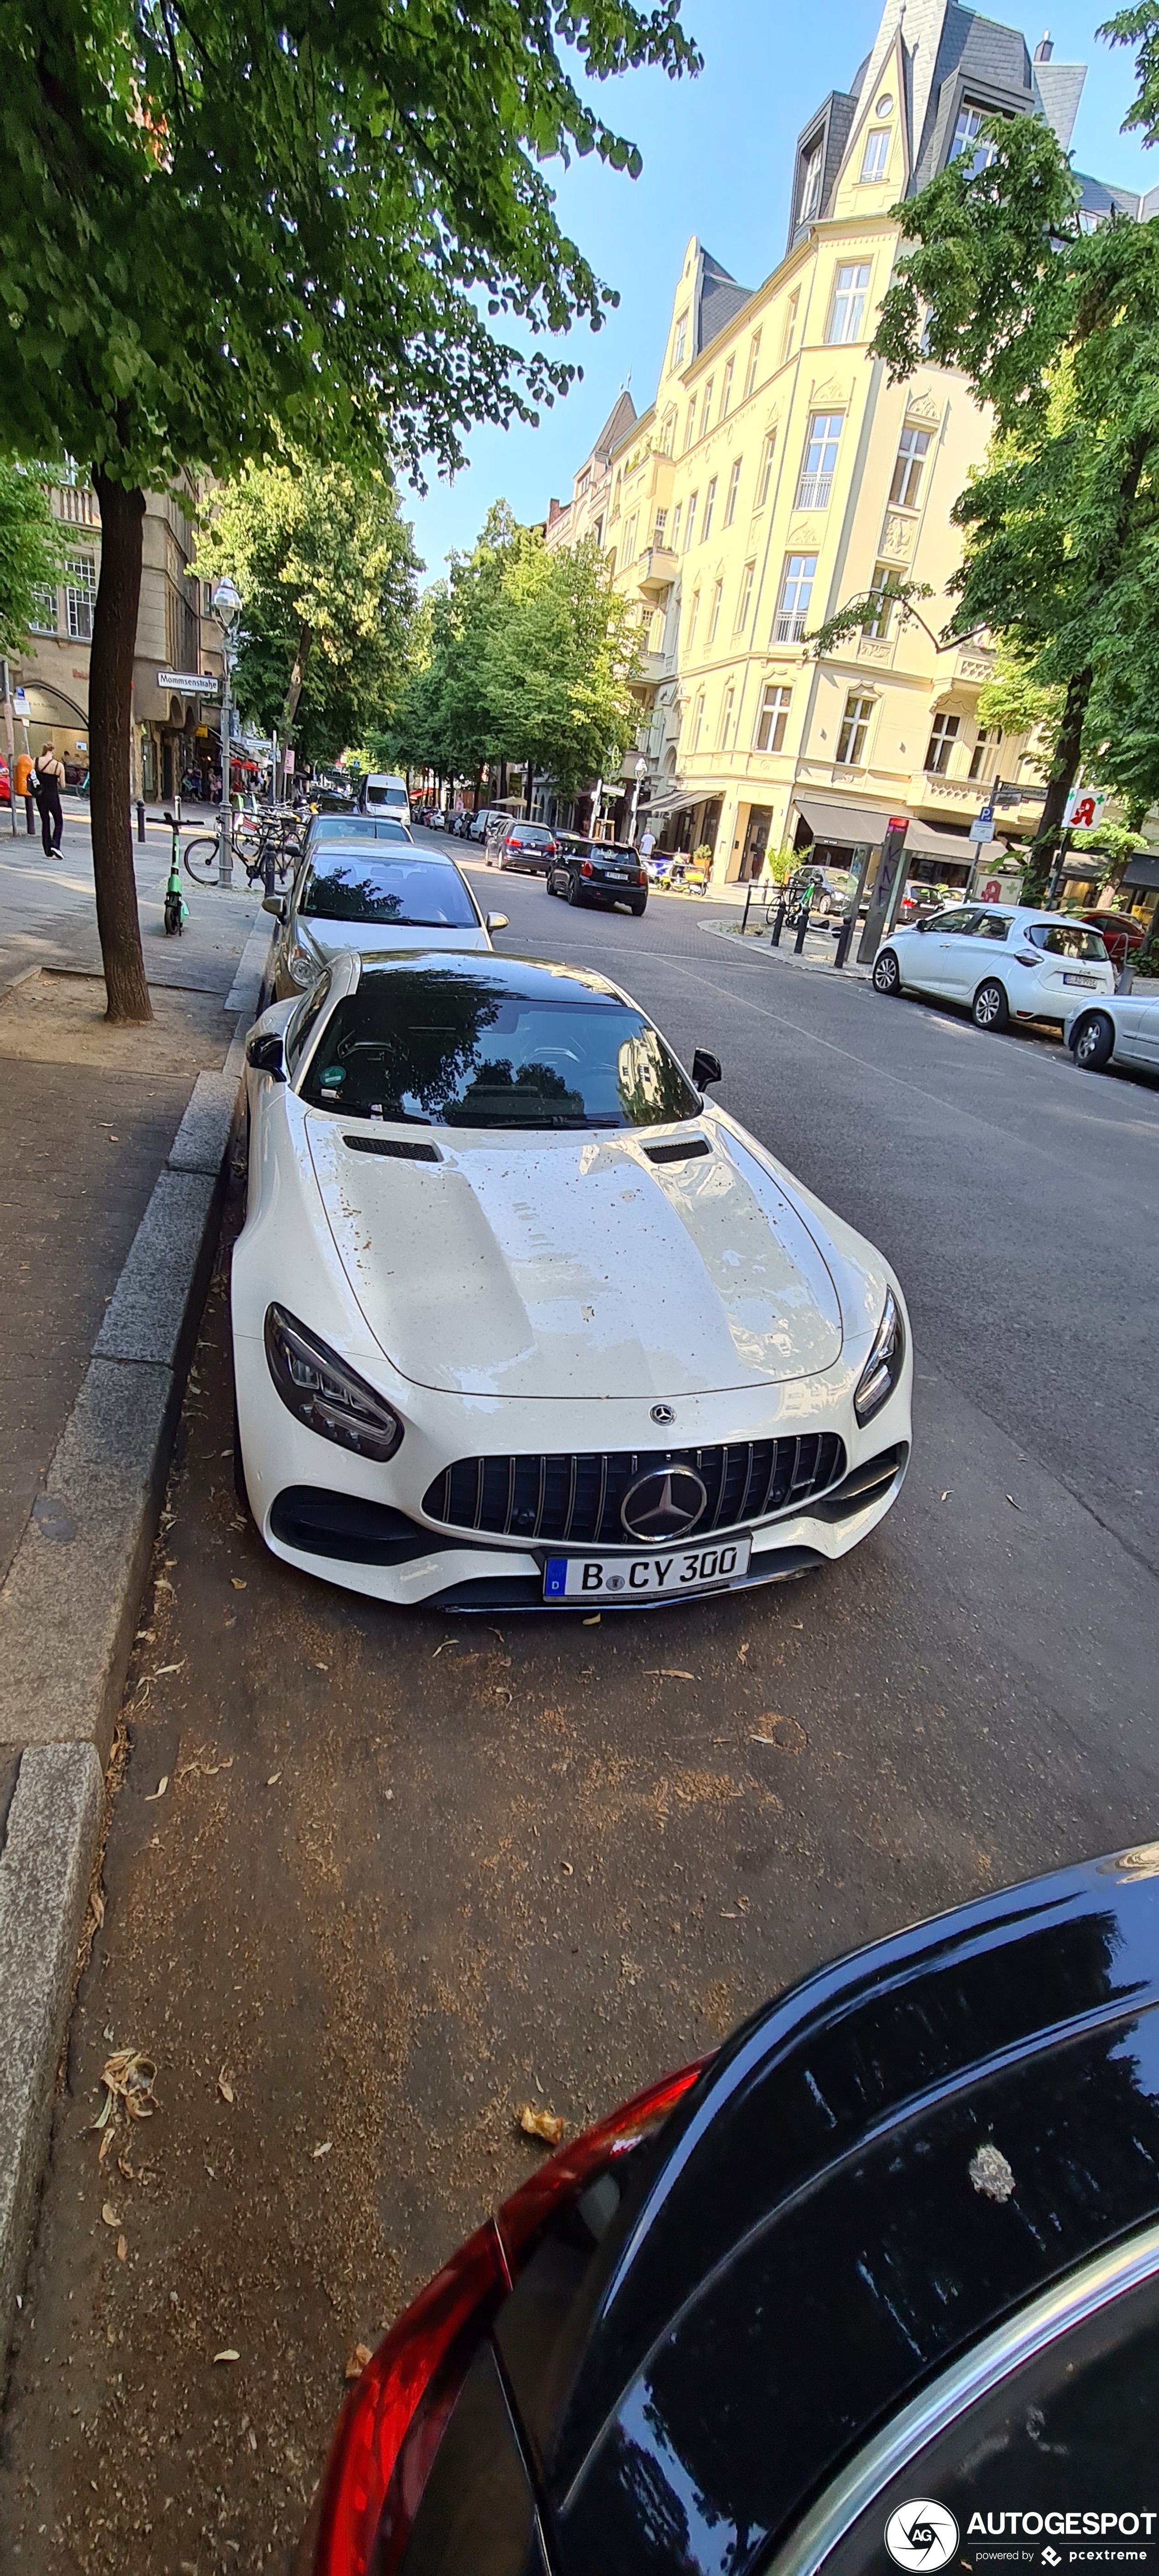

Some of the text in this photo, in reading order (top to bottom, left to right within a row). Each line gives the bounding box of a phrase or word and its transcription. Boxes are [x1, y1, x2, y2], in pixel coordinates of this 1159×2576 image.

[160, 674, 217, 690] Mommsenstraße
[981, 808, 990, 820] P
[582, 1563, 603, 1590] B
[629, 1559, 674, 1588] CY
[680, 1547, 737, 1582] 300
[551, 1581, 559, 1590] D
